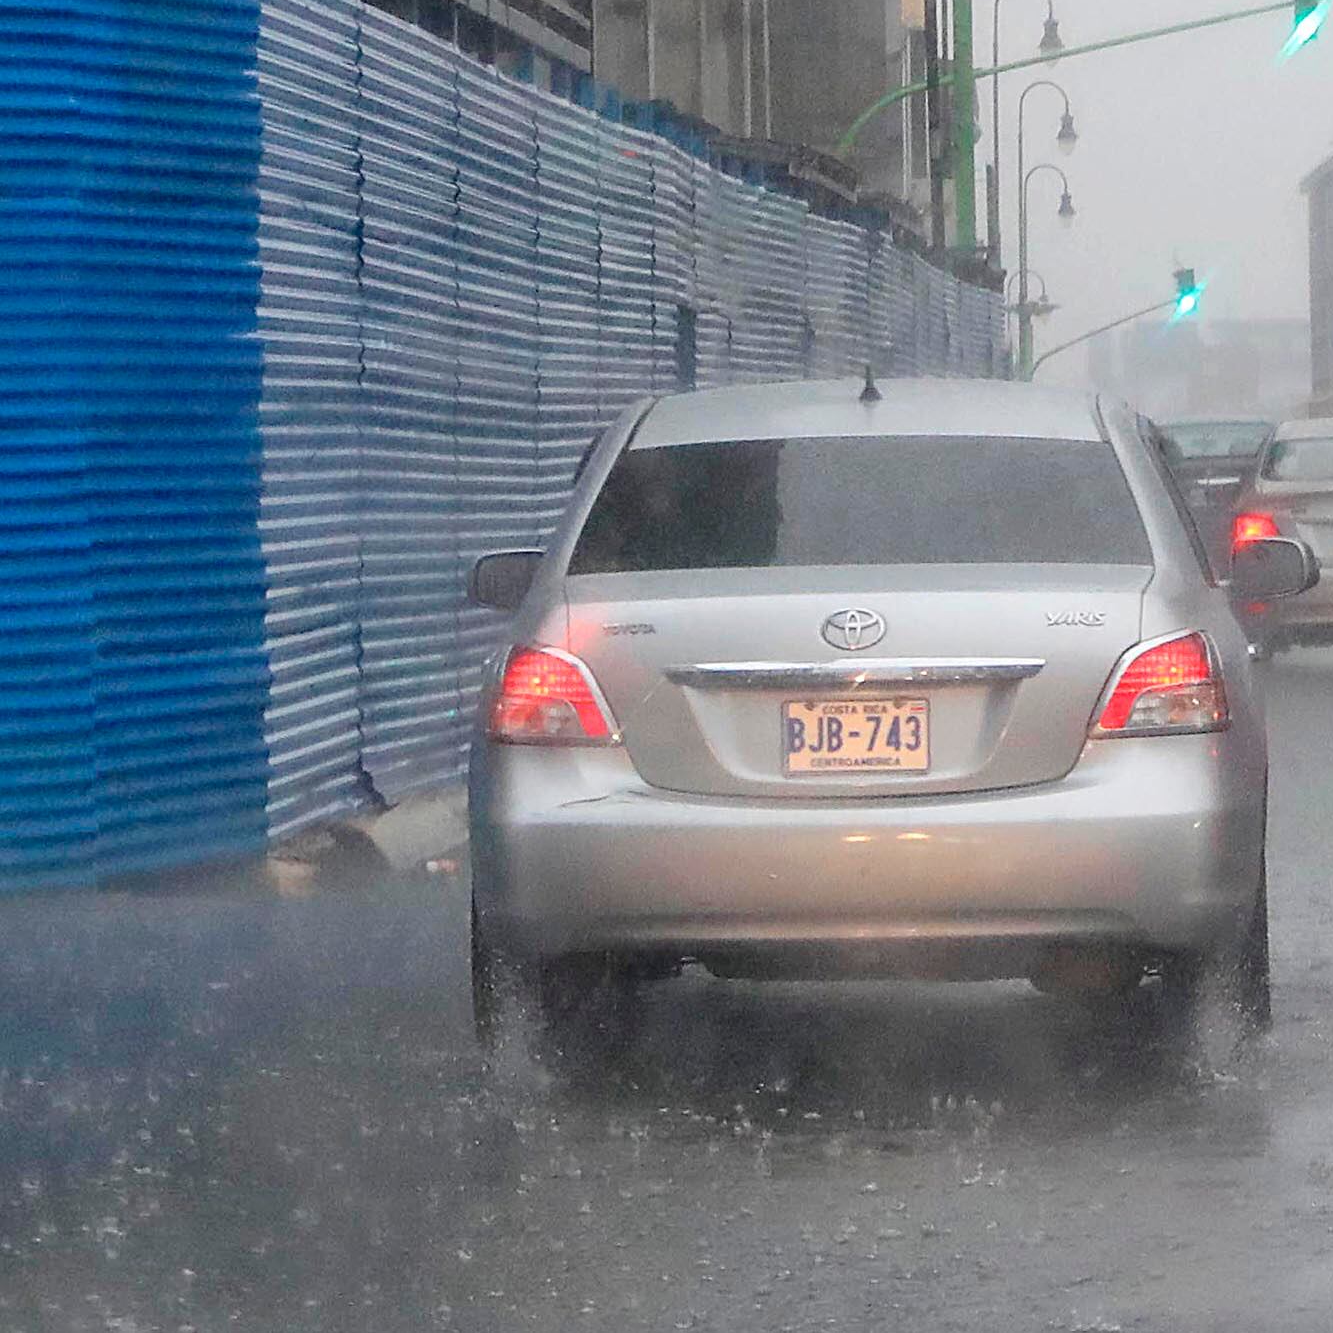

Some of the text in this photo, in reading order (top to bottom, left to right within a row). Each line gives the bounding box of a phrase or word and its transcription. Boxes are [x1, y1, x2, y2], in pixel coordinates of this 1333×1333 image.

[1045, 611, 1106, 627] YARIS
[822, 704, 888, 716] COSTA RICA
[785, 716, 921, 753] BJB-743
[811, 756, 901, 767] CENTROAMERICA
